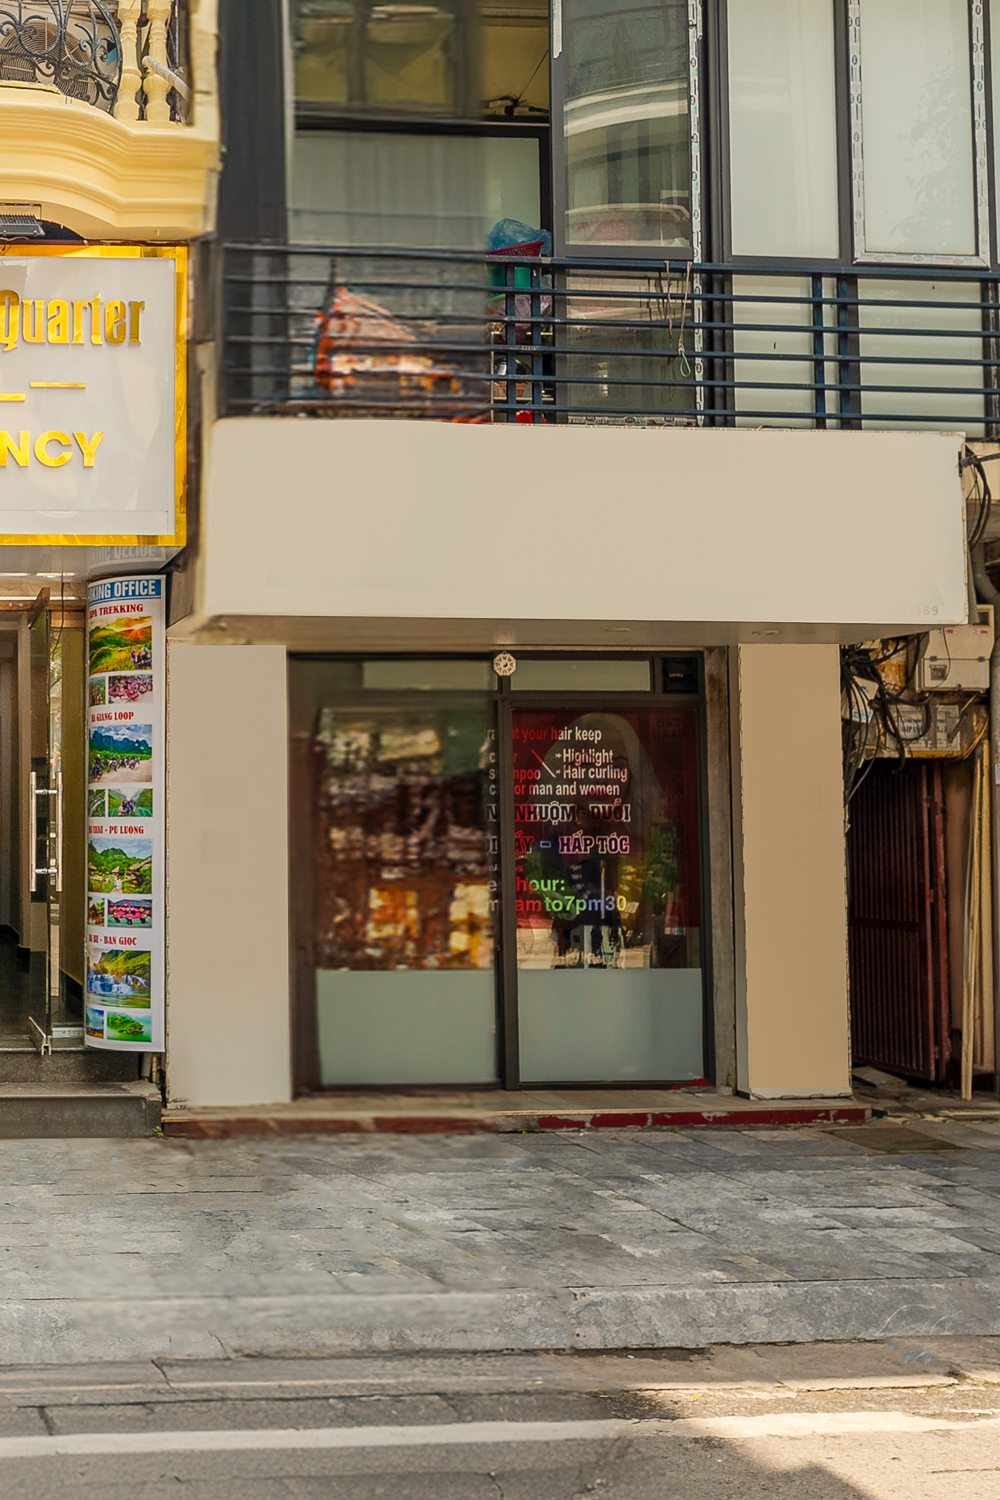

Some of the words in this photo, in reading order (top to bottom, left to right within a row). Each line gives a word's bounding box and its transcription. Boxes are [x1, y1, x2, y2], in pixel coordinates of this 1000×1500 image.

[113, 580, 156, 597] OFFICE
[99, 603, 144, 616] TREKKING
[114, 711, 134, 720] LOOP
[522, 729, 548, 744] your
[551, 726, 573, 741] hair
[575, 726, 602, 744] keep
[563, 749, 614, 767] Highlight
[563, 765, 586, 779] Hair
[588, 765, 628, 782] curling
[529, 785, 553, 796] man
[556, 781, 577, 796] and
[580, 785, 620, 796] women
[109, 825, 119, 834] PU
[120, 825, 145, 834] LUONG
[558, 830, 595, 854] HẤP
[595, 832, 630, 854] TÓC
[118, 936, 137, 945] GIOC
